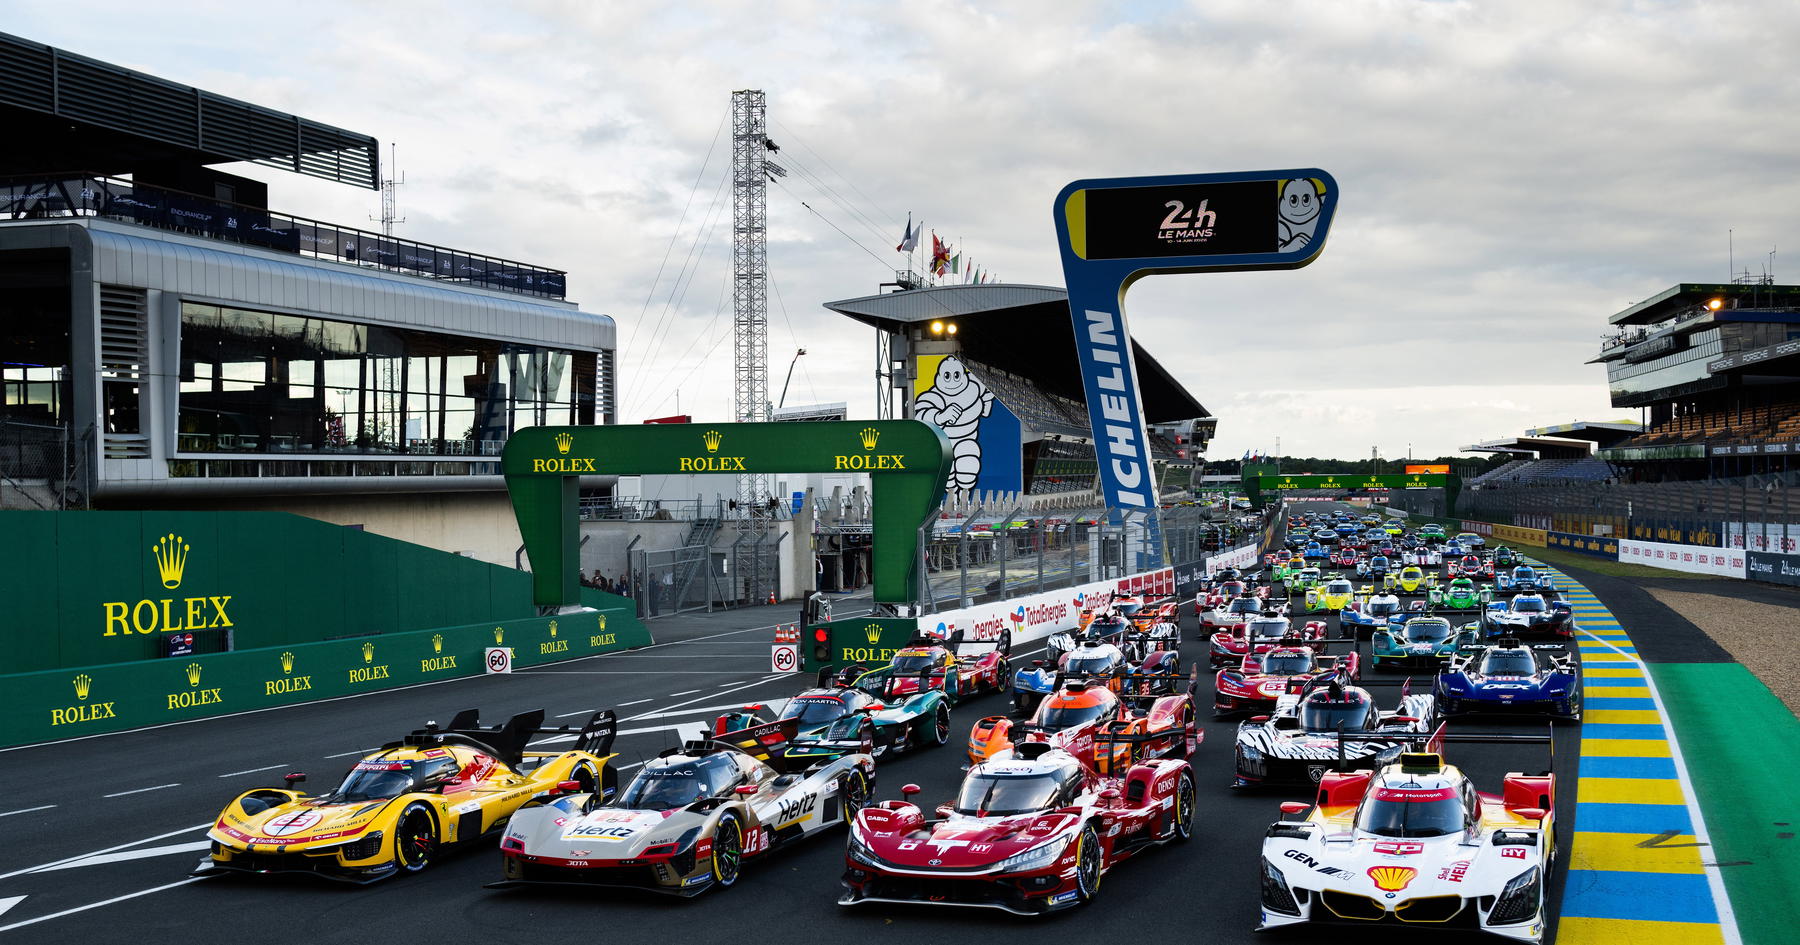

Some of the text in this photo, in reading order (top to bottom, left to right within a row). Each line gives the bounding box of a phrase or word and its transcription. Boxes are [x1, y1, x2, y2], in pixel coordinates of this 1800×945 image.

[1158, 229, 1213, 239] LE MANS
[1085, 309, 1153, 554] MICHELIN
[533, 458, 596, 473] ROLEX
[679, 456, 747, 471] ROLEX
[834, 454, 906, 470] ROLEX
[1781, 537, 1796, 551] BSCH
[103, 595, 234, 637] ROLEX
[1026, 600, 1067, 627] TotalEnergies
[947, 614, 1004, 641] Tnergies
[540, 639, 569, 655] ROLEX
[590, 633, 616, 648] ROLEX
[421, 656, 457, 673] ROLEX
[490, 654, 505, 667] 60
[777, 653, 794, 665] 60
[348, 664, 390, 684] ROLEX
[265, 675, 313, 696] ROLEX
[167, 687, 223, 710] ROLEX
[51, 701, 117, 726] ROLEX
[754, 724, 781, 737] CADILLAC
[1157, 778, 1175, 794] DENSO
[777, 791, 818, 825] Hertz
[567, 826, 635, 838] Hertz
[743, 829, 758, 854] 12
[970, 844, 991, 852] HY
[1284, 849, 1320, 869] GEN
[1503, 848, 1525, 857] HY
